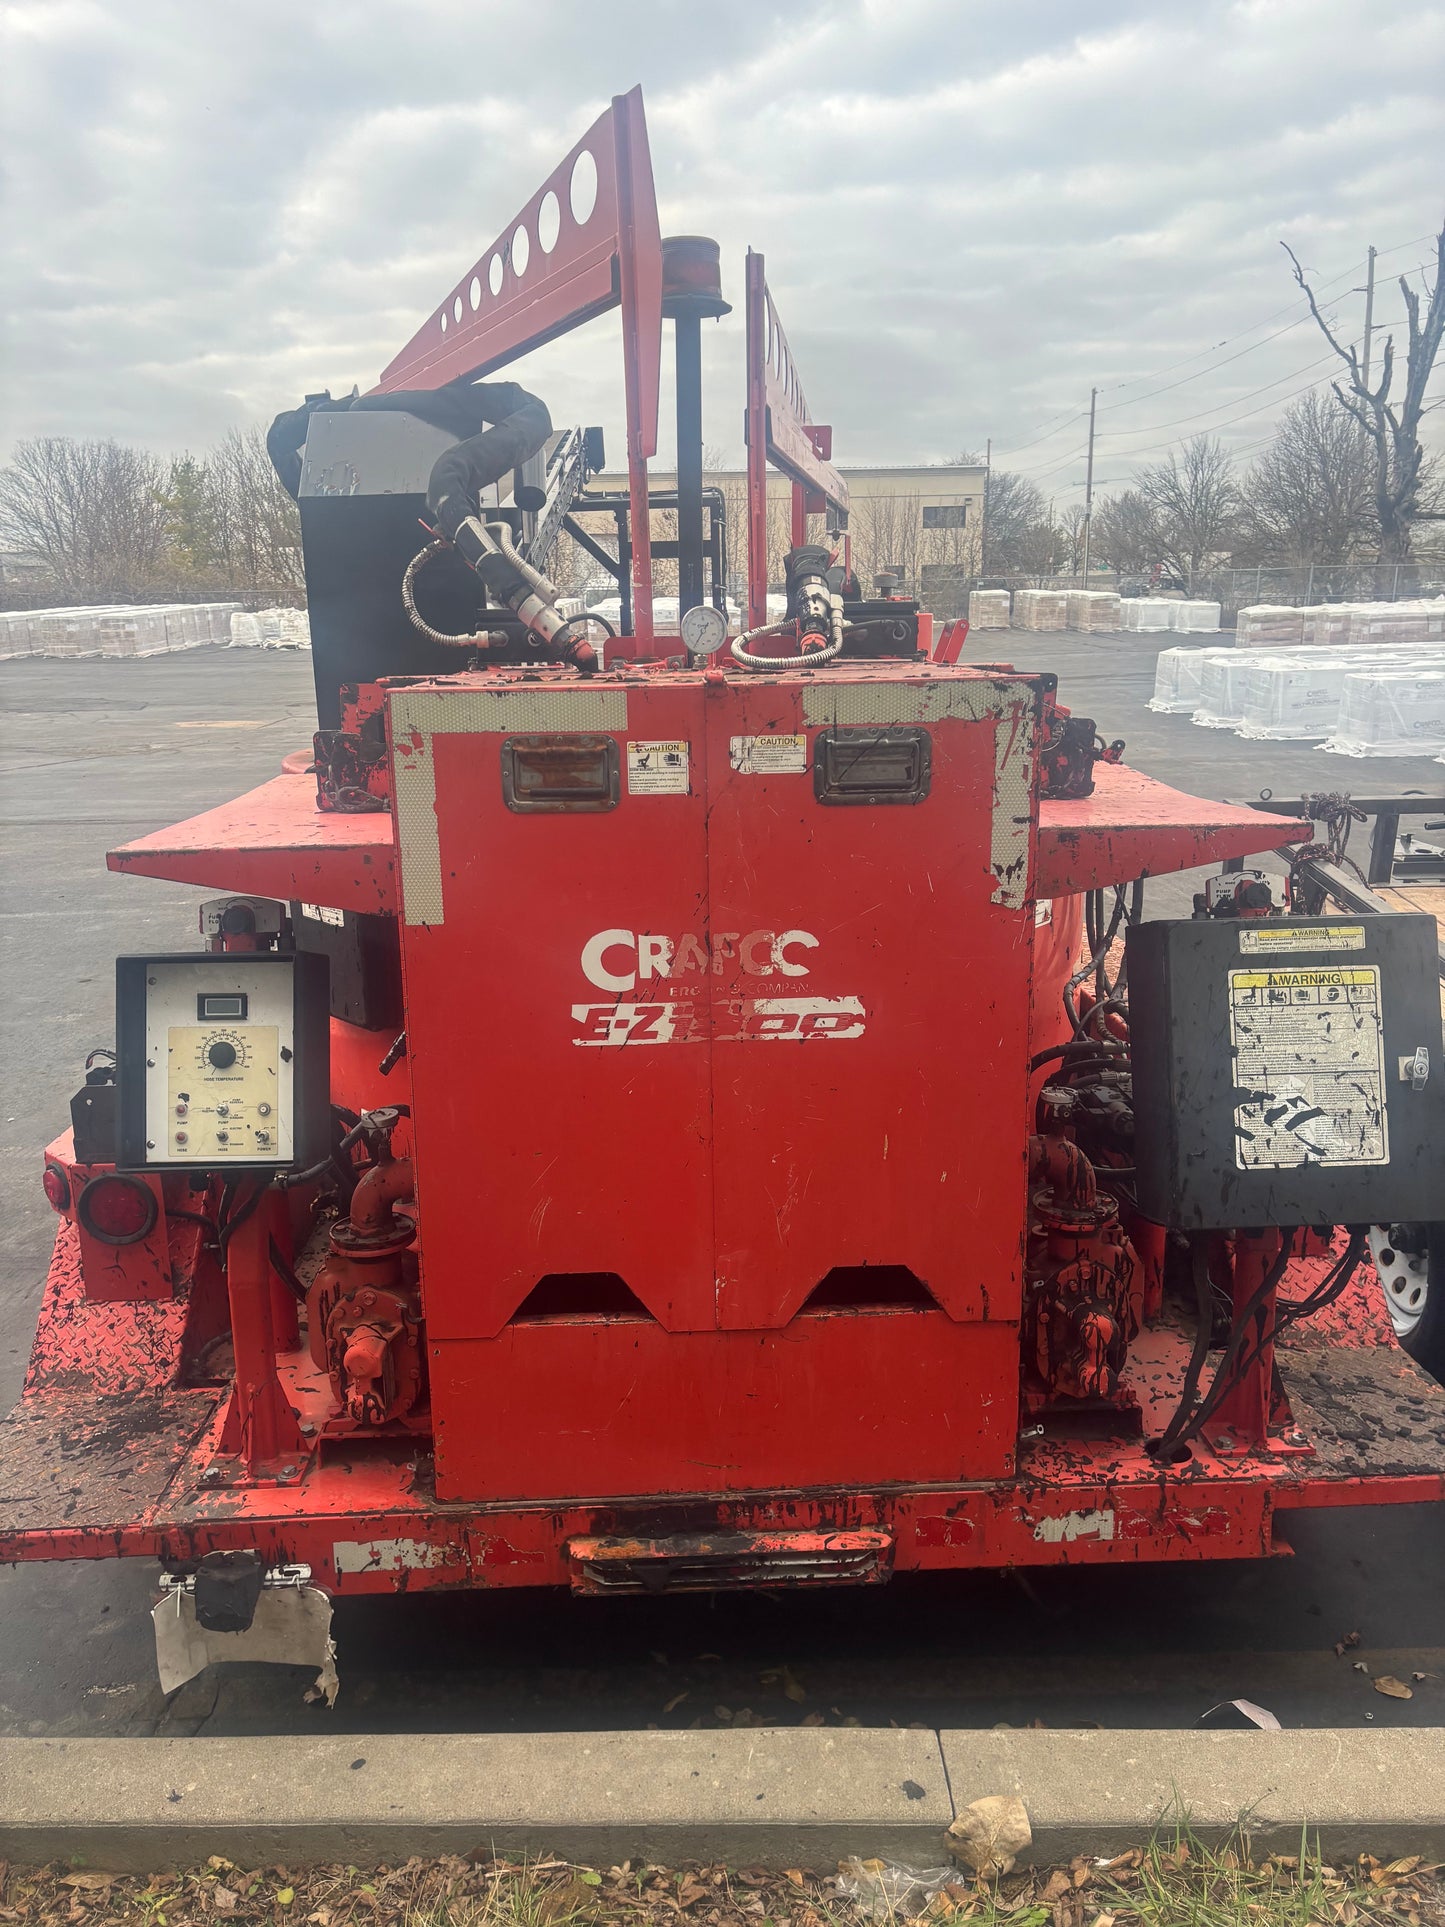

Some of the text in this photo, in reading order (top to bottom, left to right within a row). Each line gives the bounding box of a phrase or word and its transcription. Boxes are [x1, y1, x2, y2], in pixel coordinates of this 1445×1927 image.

[760, 737, 796, 746] CAUTION
[1278, 973, 1341, 985] WARNING
[747, 982, 814, 995] COMPAN
